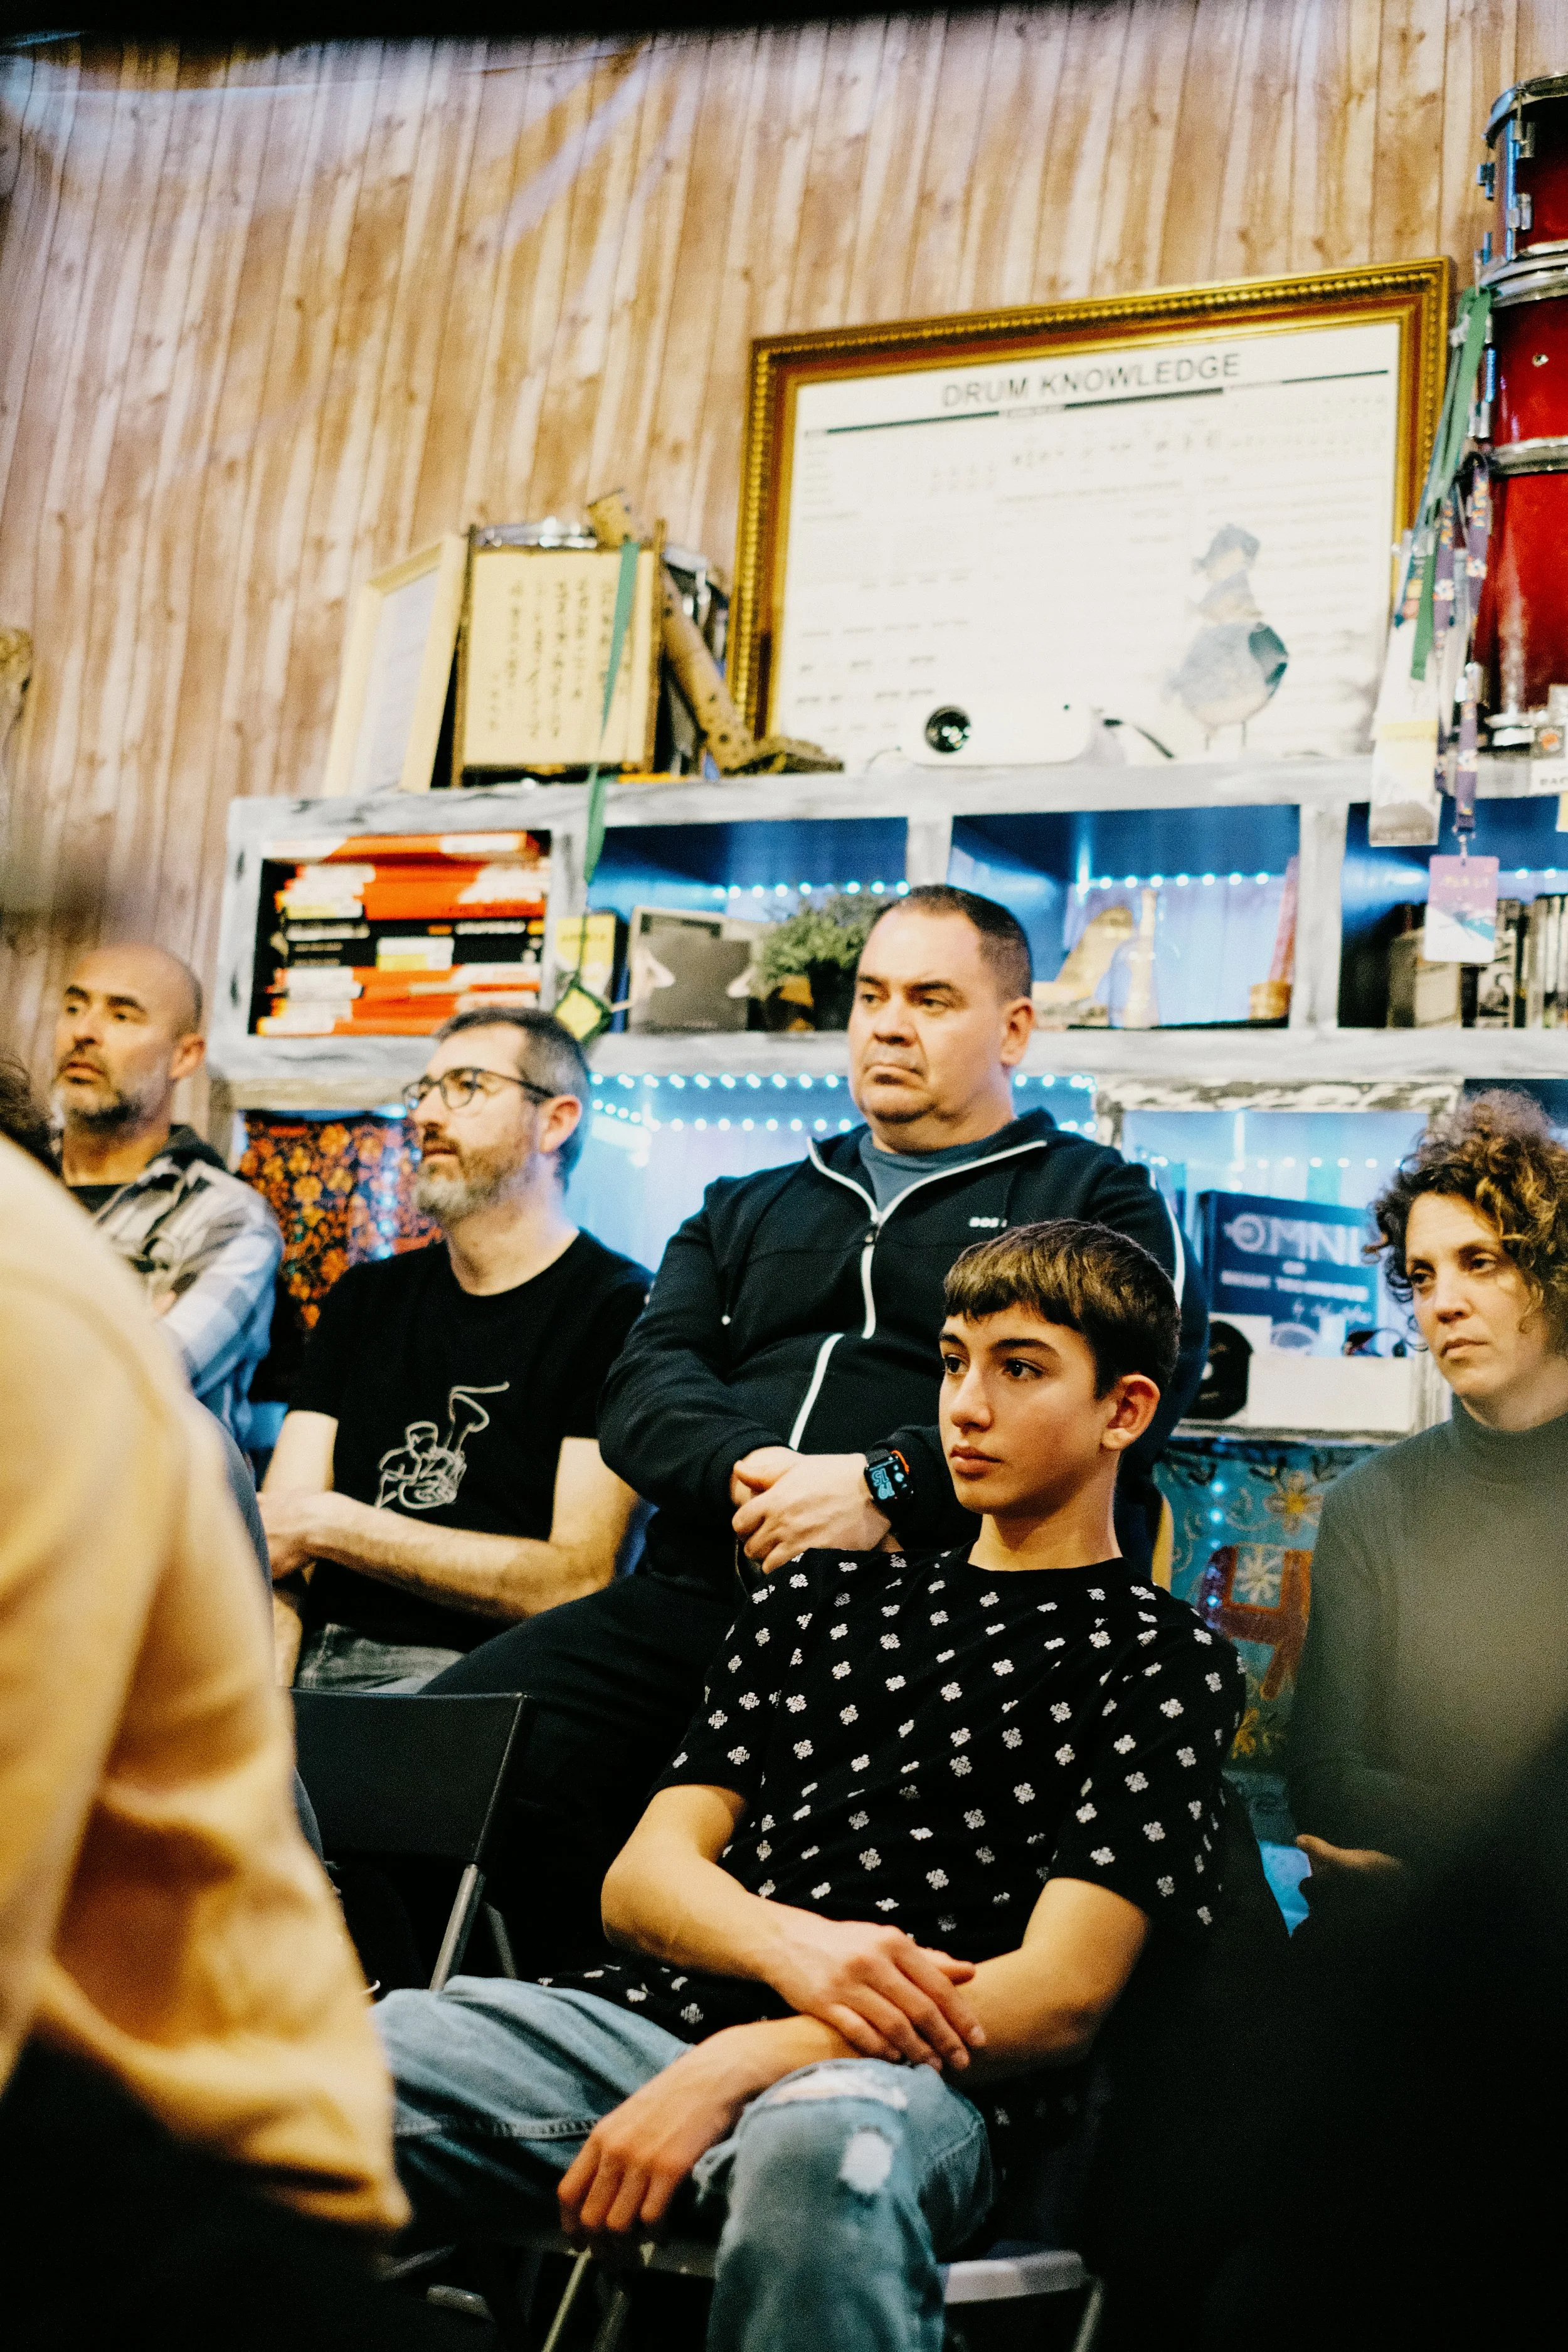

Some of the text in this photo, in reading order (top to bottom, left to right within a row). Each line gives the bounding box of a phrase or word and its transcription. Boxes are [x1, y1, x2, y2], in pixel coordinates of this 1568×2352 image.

[943, 378, 1028, 407] DRUM
[1040, 354, 1239, 393] KNOWLEDGE
[1223, 1212, 1360, 1267] OMNI
